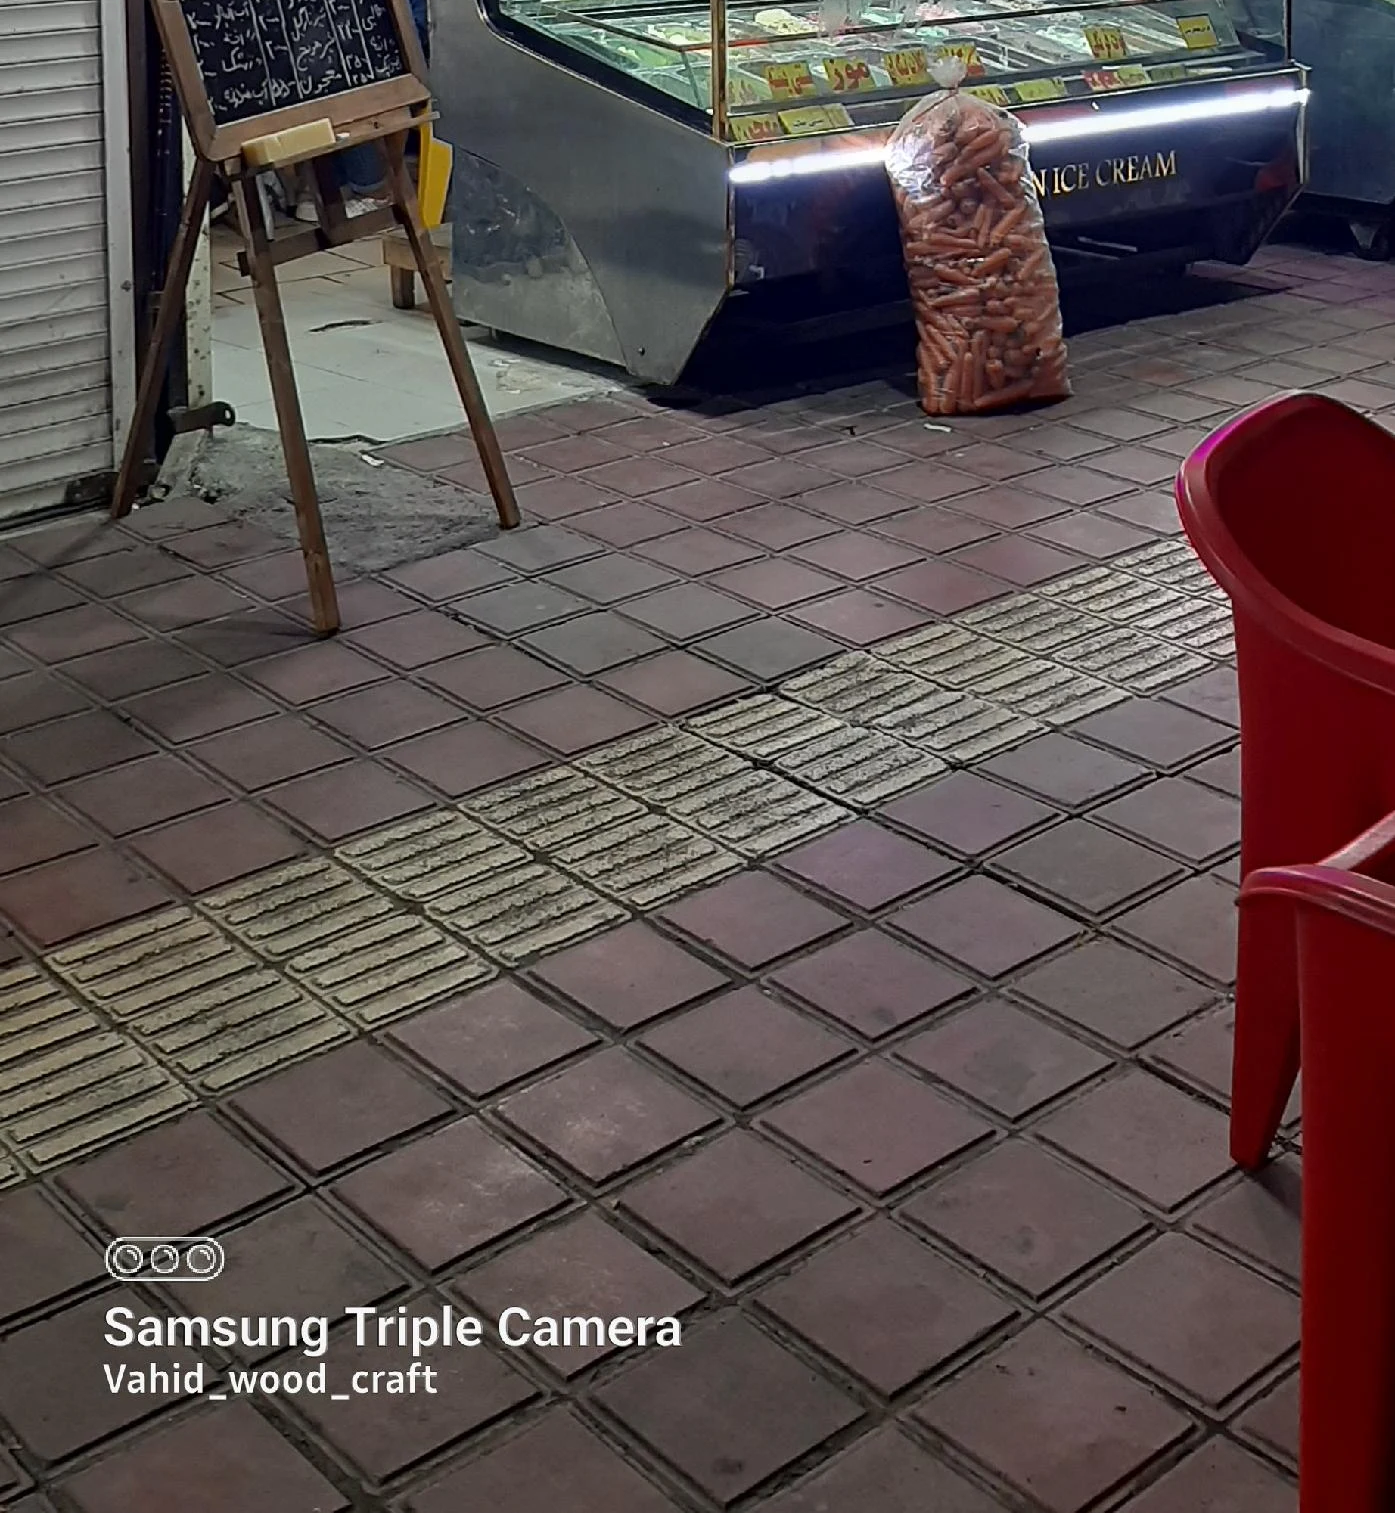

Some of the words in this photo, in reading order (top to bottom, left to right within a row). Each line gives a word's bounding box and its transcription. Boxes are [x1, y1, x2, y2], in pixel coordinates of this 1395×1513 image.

[1030, 169, 1047, 197] N
[1052, 161, 1090, 194] ICE
[1095, 149, 1178, 186] CREAM
